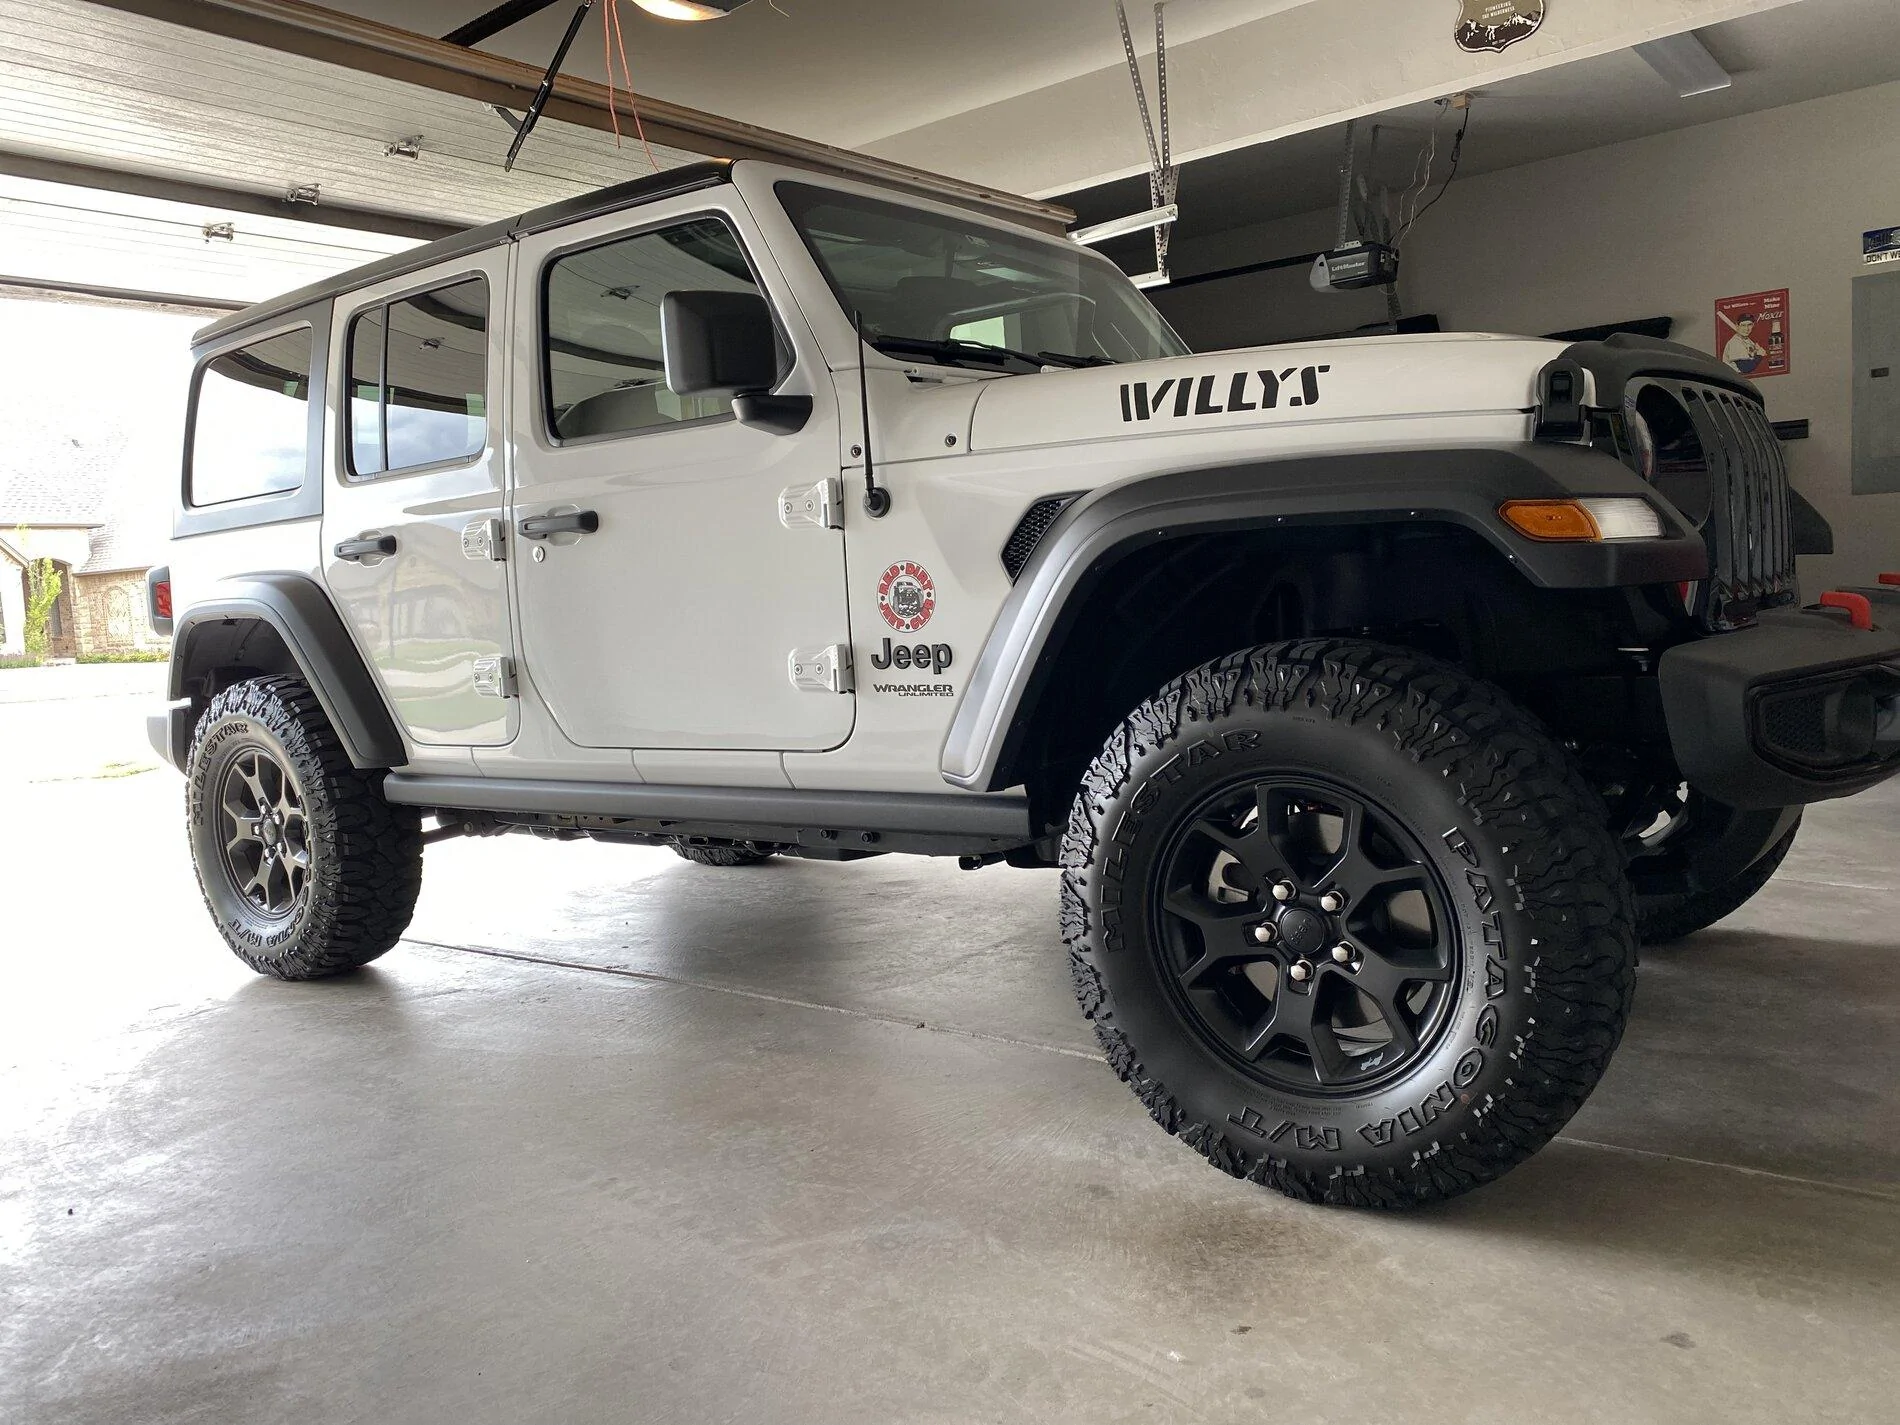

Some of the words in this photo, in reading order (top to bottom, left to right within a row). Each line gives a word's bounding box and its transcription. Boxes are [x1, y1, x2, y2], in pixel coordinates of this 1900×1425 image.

[1120, 364, 1331, 422] WILLYS
[878, 565, 900, 596] RED
[905, 562, 933, 591] DIRT
[880, 601, 906, 629] JEEP
[909, 598, 934, 630] CLUB
[870, 637, 953, 675] Jeep
[873, 683, 953, 692] WRANGLER
[192, 722, 249, 827] MILESTAR
[1100, 728, 1262, 952] MILESTAR
[1355, 826, 1506, 1148] PATAGONIA
[1225, 1105, 1342, 1152] M/T
